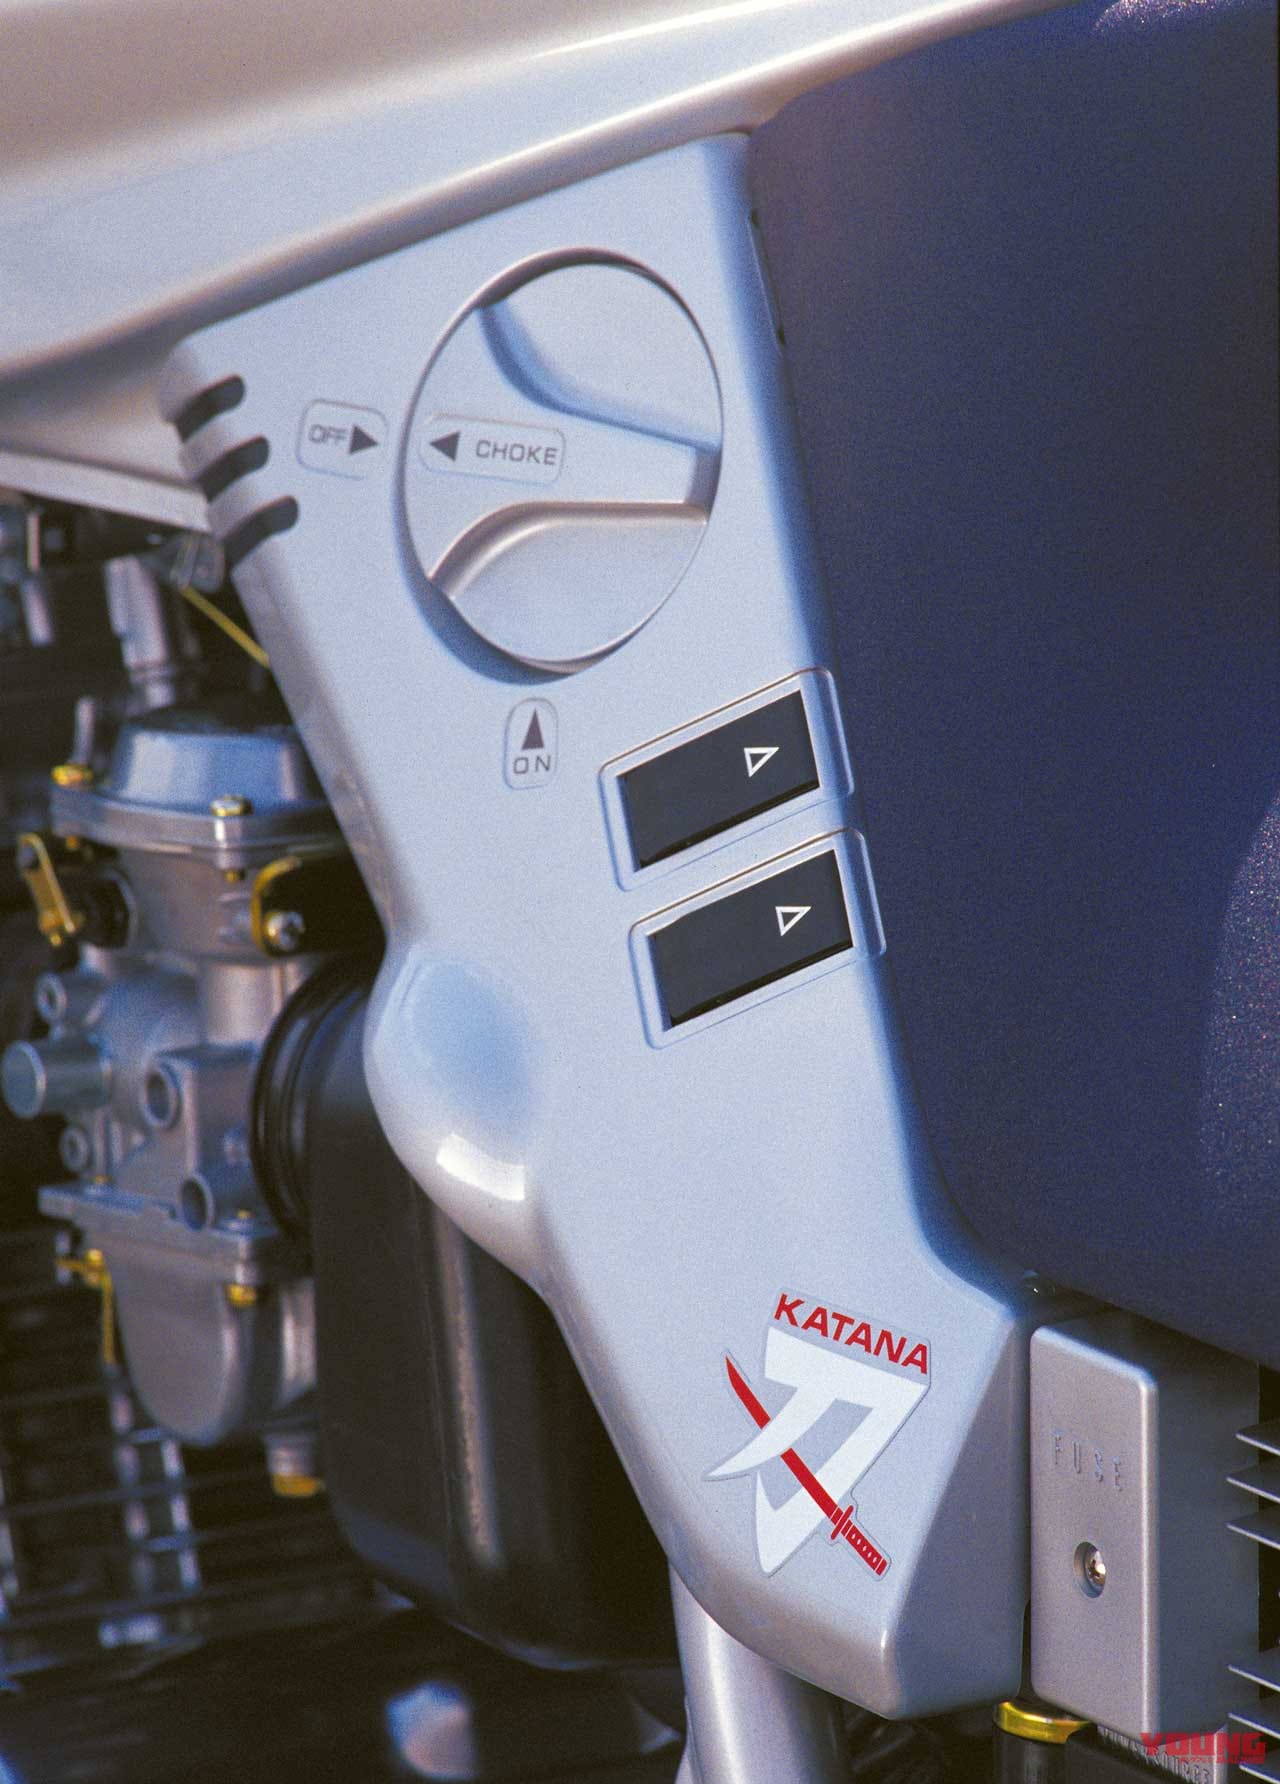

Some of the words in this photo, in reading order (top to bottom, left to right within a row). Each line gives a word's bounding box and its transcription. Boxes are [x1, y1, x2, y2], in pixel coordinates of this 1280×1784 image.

[308, 424, 348, 446] OFF
[475, 439, 559, 466] CHOKE
[513, 754, 551, 775] ON
[774, 1293, 928, 1375] KATANA
[1051, 1430, 1122, 1491] FUSE
